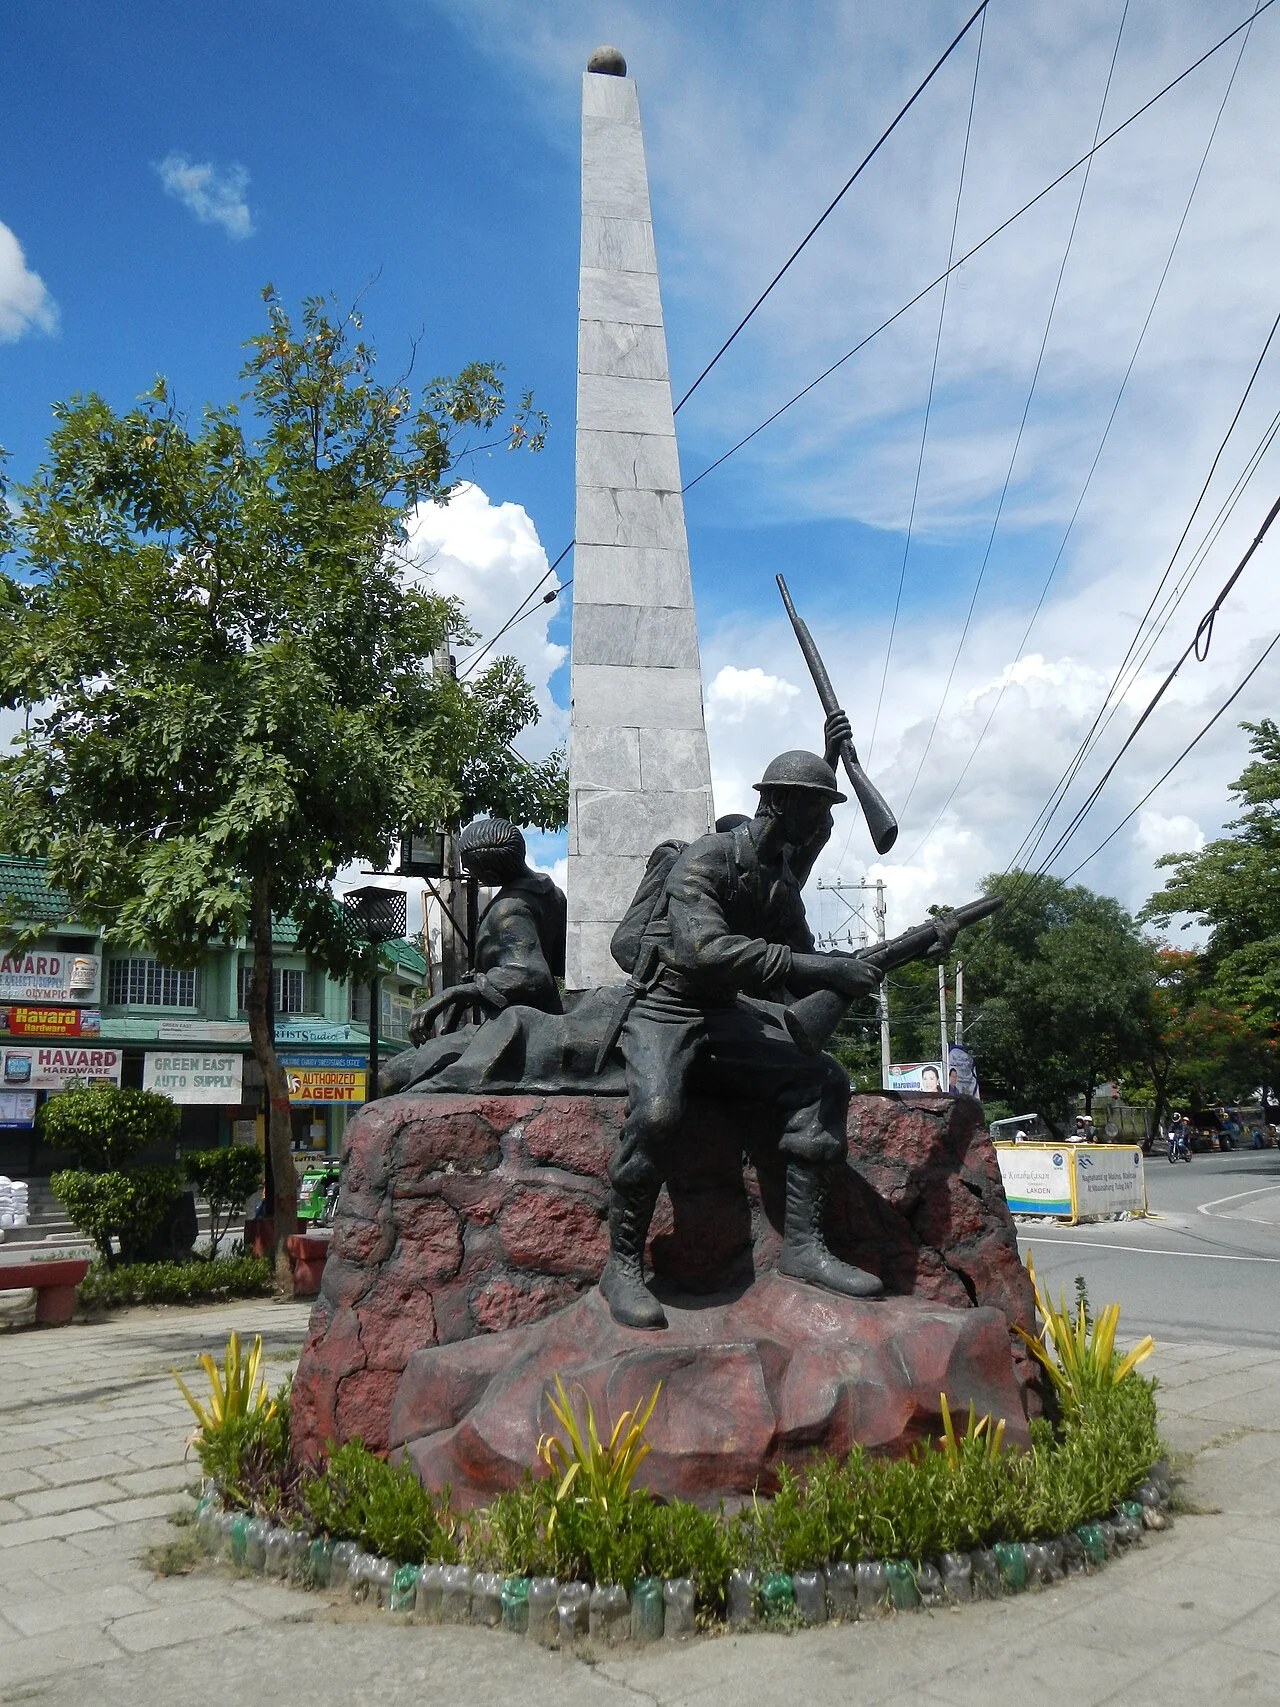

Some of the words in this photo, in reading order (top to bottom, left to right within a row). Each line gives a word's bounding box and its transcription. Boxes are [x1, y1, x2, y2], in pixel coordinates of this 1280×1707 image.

[0, 955, 60, 975] AVARD
[39, 976, 63, 988] SUPPLY
[26, 988, 67, 999] OLYMPIC
[16, 1008, 76, 1024] Havard
[24, 1024, 66, 1032] Hardware
[274, 1031, 301, 1039] RTIST
[38, 1049, 117, 1066] HAVARD
[154, 1058, 200, 1071] GREEN
[202, 1058, 235, 1071] EAST
[43, 1067, 110, 1075] HARDWARE
[154, 1075, 186, 1087] AUTO
[193, 1075, 233, 1088] SUPPLY
[303, 1073, 355, 1084] AUTHORIZED
[893, 1081, 920, 1089] Maraming
[301, 1087, 355, 1100] AGENT
